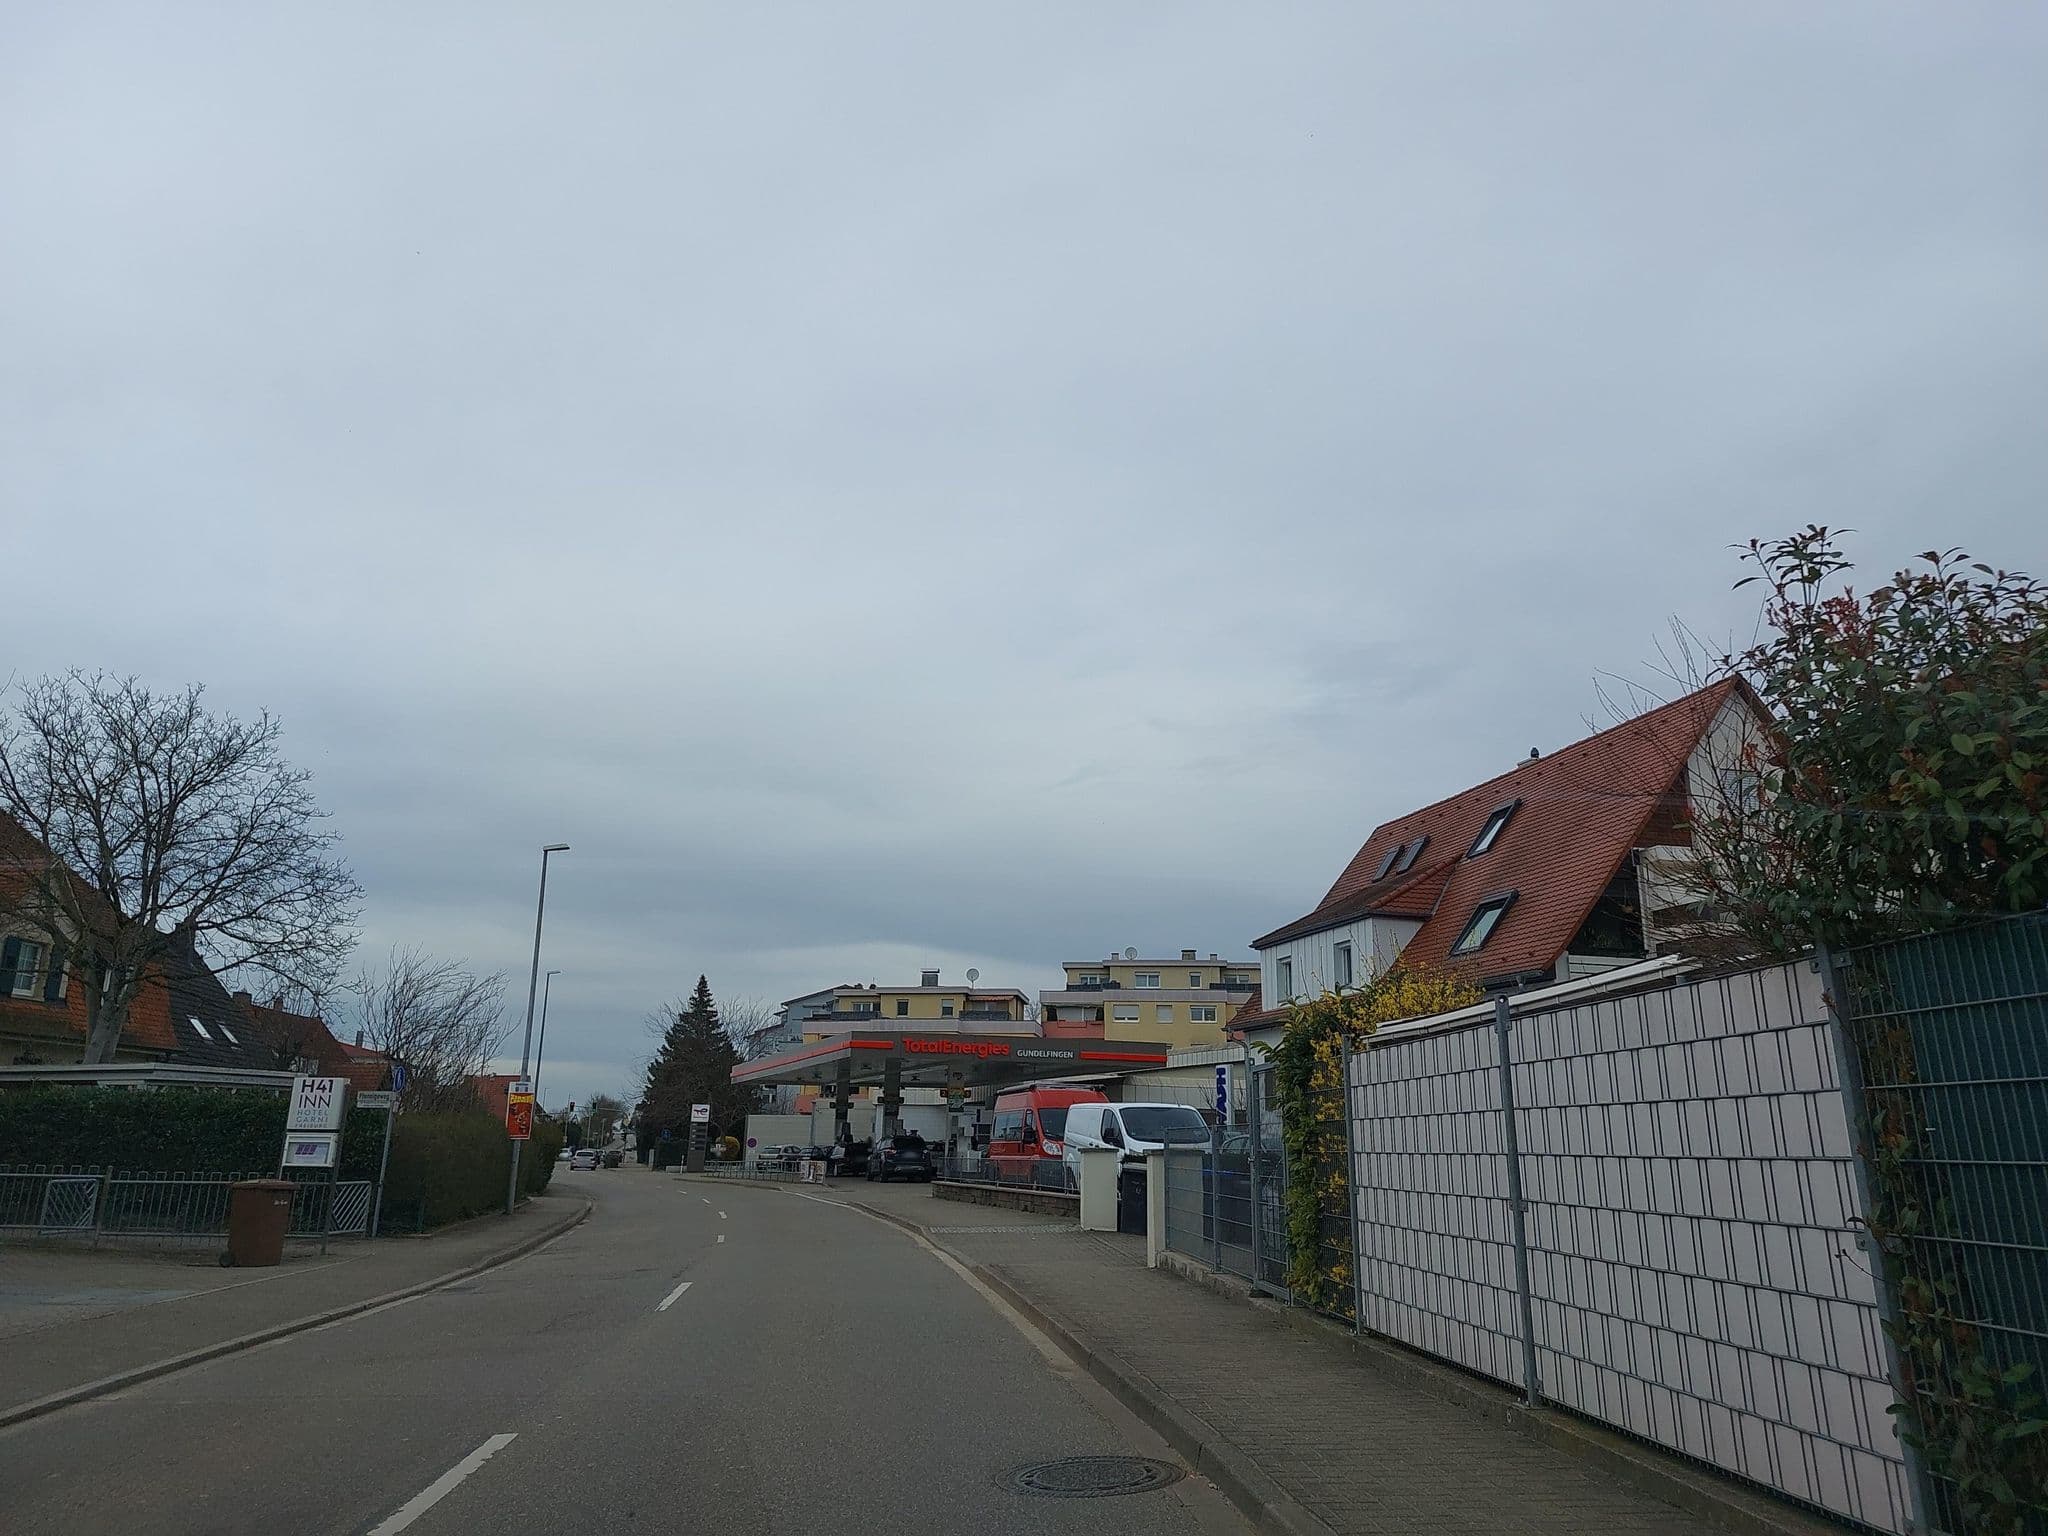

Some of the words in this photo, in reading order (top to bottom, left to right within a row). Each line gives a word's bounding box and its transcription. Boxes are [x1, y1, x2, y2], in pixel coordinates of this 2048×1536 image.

[903, 1038, 1010, 1059] TotalEnergies
[1017, 1049, 1074, 1059] GUNDELFINGEN
[301, 1079, 334, 1093] H41
[299, 1094, 331, 1109] INN
